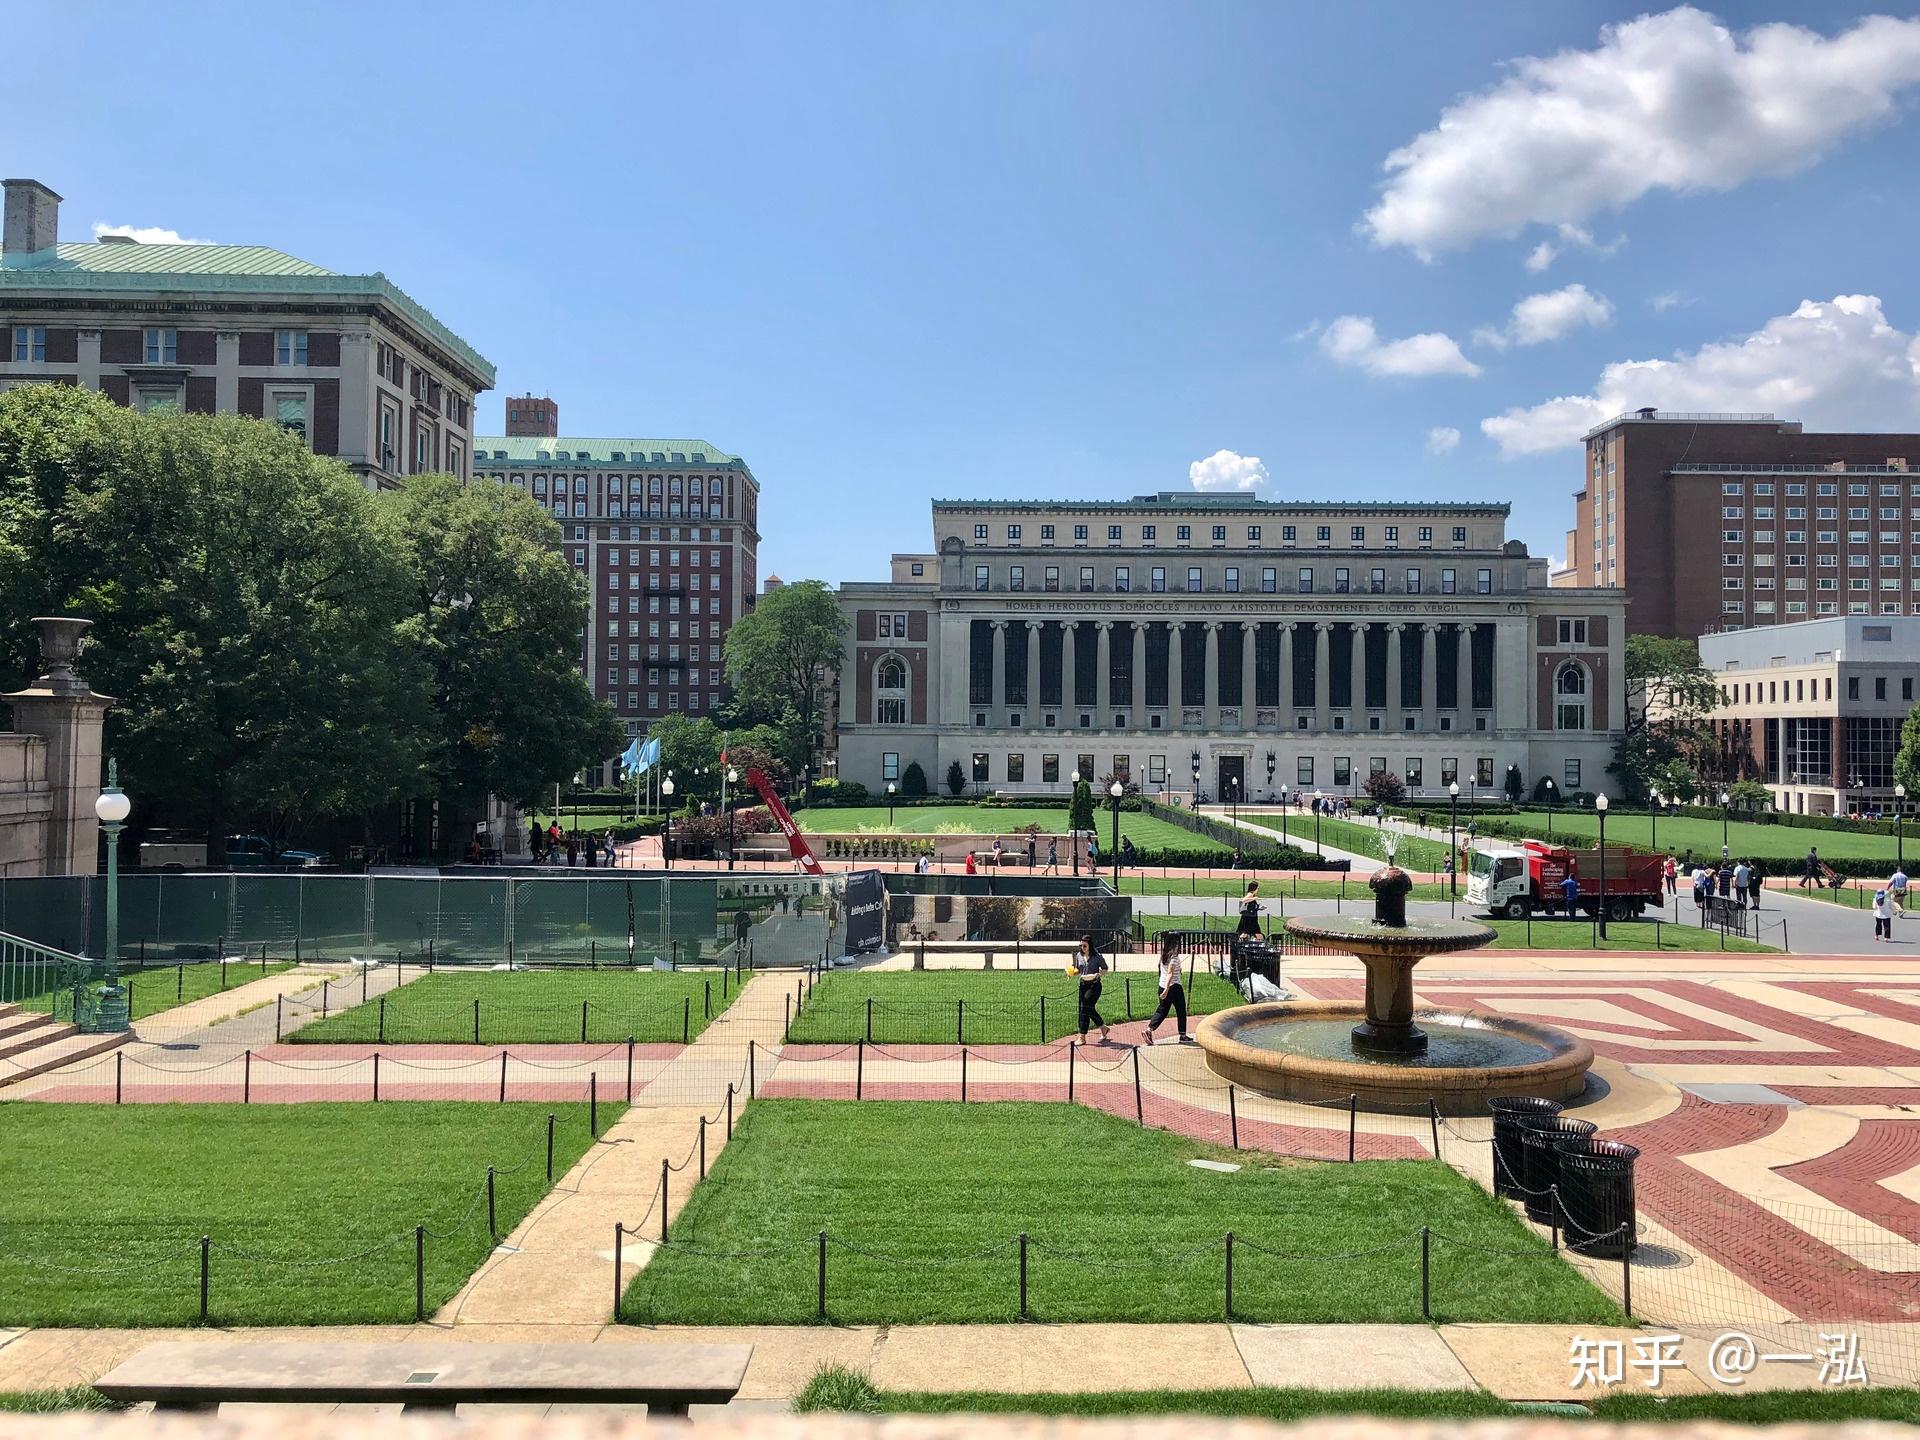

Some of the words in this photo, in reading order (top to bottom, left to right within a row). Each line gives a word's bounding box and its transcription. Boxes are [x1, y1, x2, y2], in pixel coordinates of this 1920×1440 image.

[1006, 602, 1041, 610] HOMER
[1048, 602, 1112, 611] HERODOTUS
[1119, 602, 1179, 611] SOPHOCLES
[1187, 603, 1222, 612] PLATO
[1230, 603, 1287, 612] ARISTOTLE
[1294, 604, 1370, 612] DEMOSTHENES
[1377, 604, 1416, 613] CICERO
[1423, 605, 1460, 613] VERGIL
